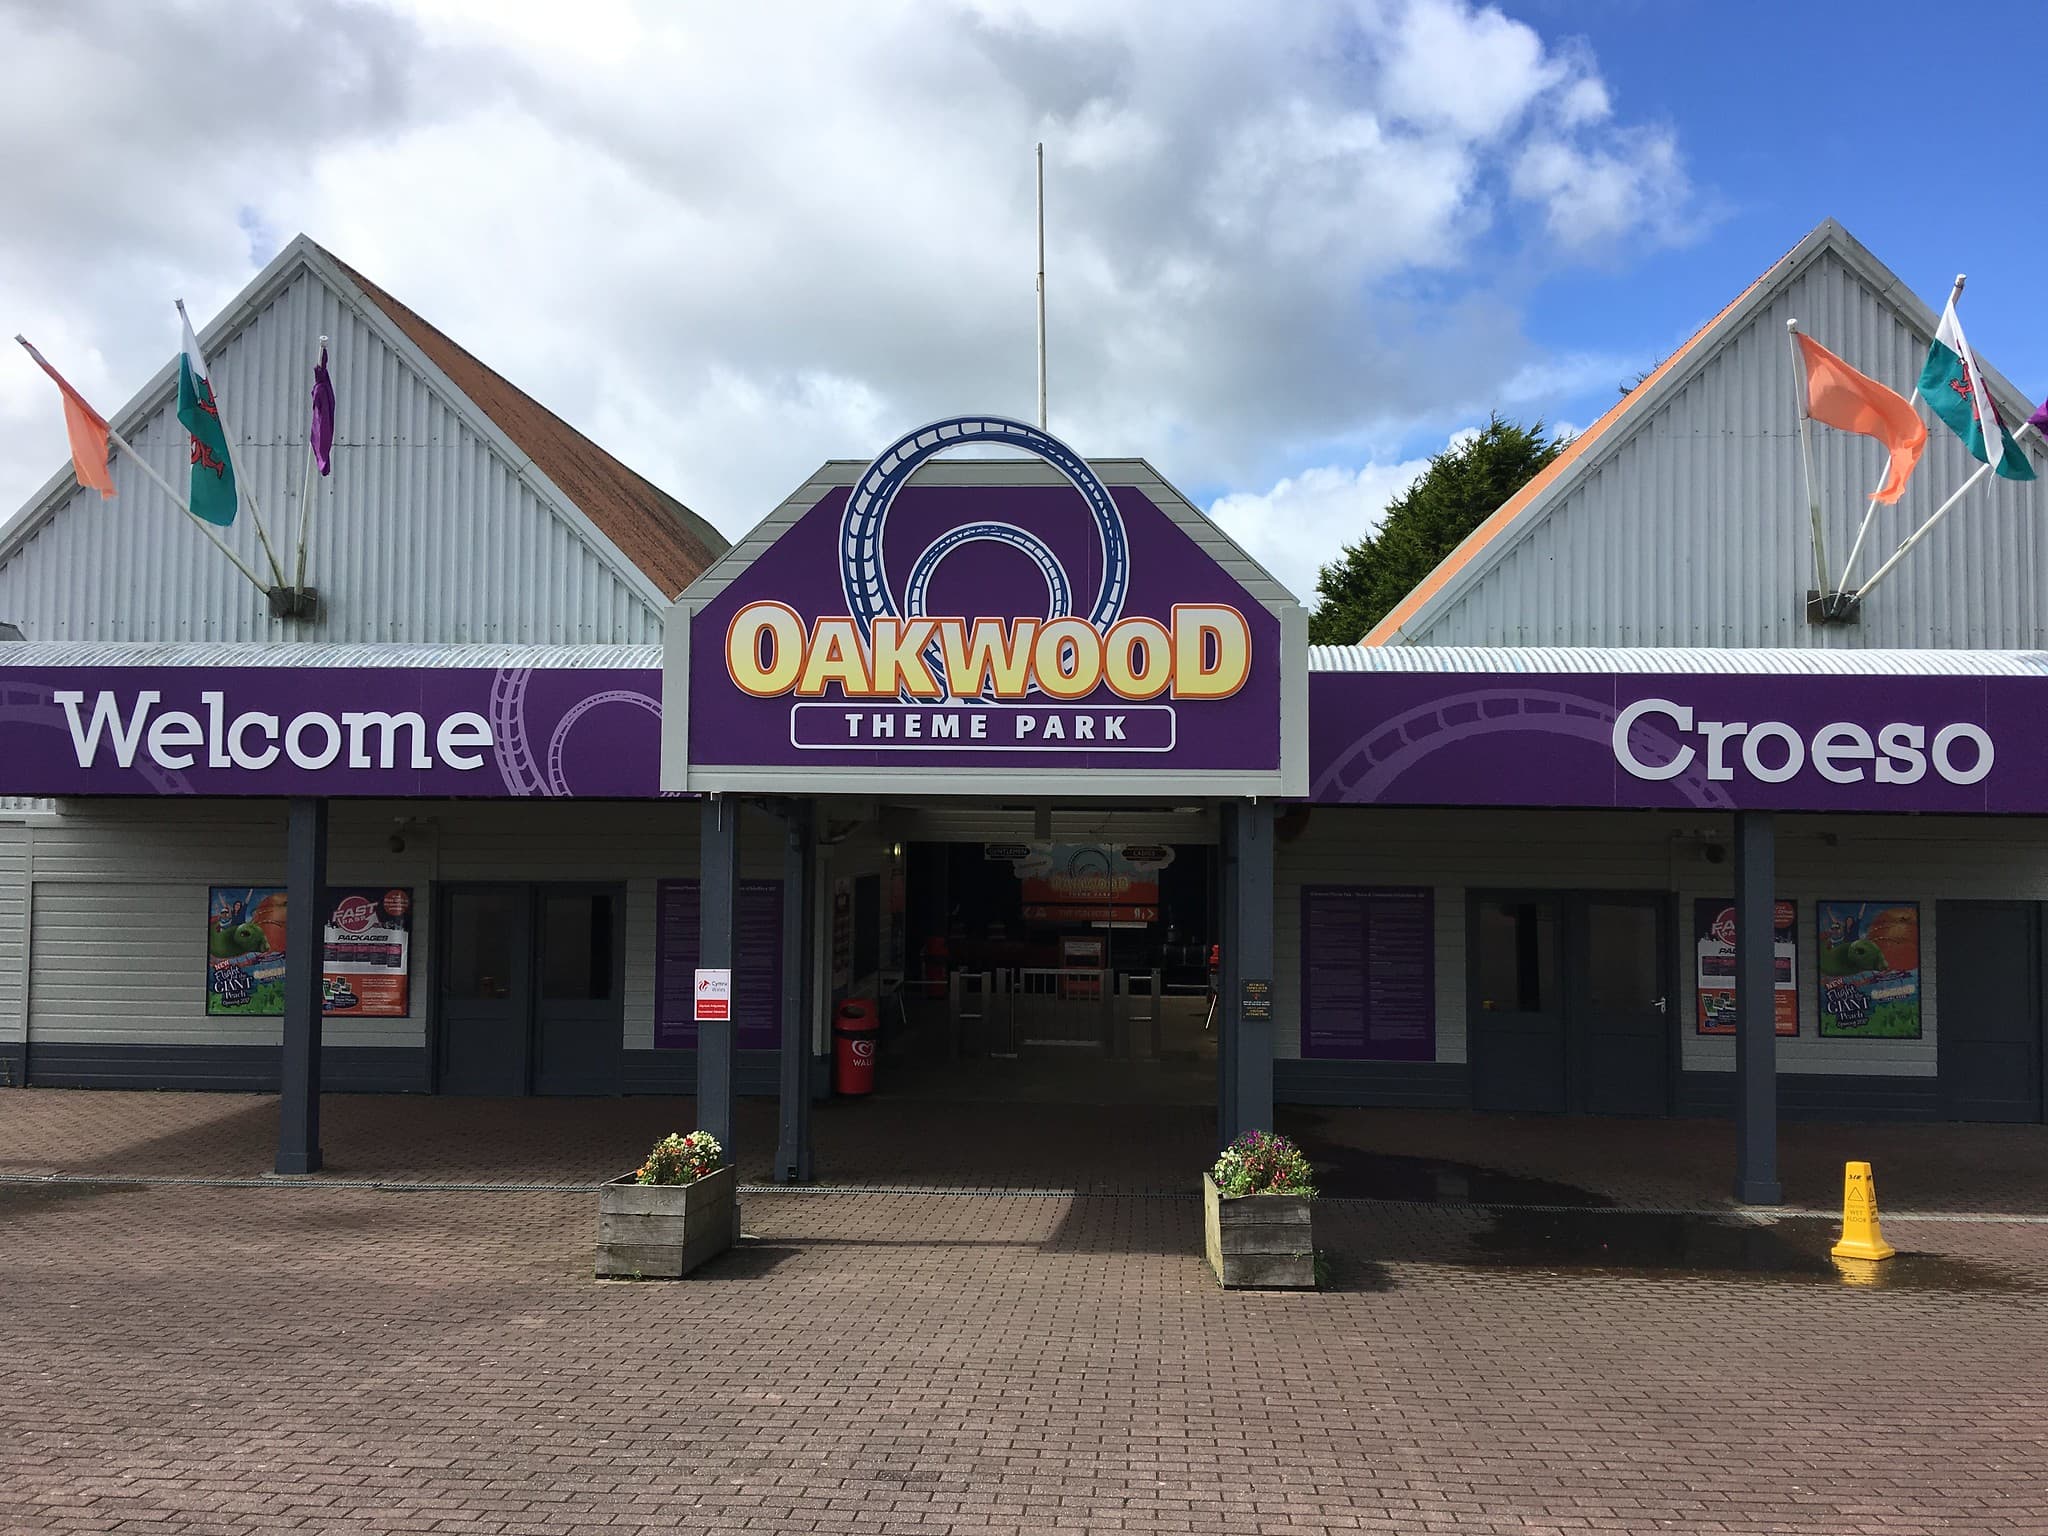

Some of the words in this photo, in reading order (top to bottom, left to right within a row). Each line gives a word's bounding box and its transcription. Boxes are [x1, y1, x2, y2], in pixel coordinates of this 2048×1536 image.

[725, 600, 1253, 700] OAKWOOD
[53, 690, 495, 770] Welcome
[845, 713, 987, 740] THEME
[1015, 715, 1127, 740] PARK
[1611, 698, 1996, 786] Croeso
[332, 902, 379, 922] FAST
[338, 934, 389, 942] PACKAGES
[1711, 919, 1736, 935] FA
[214, 959, 230, 971] NEW
